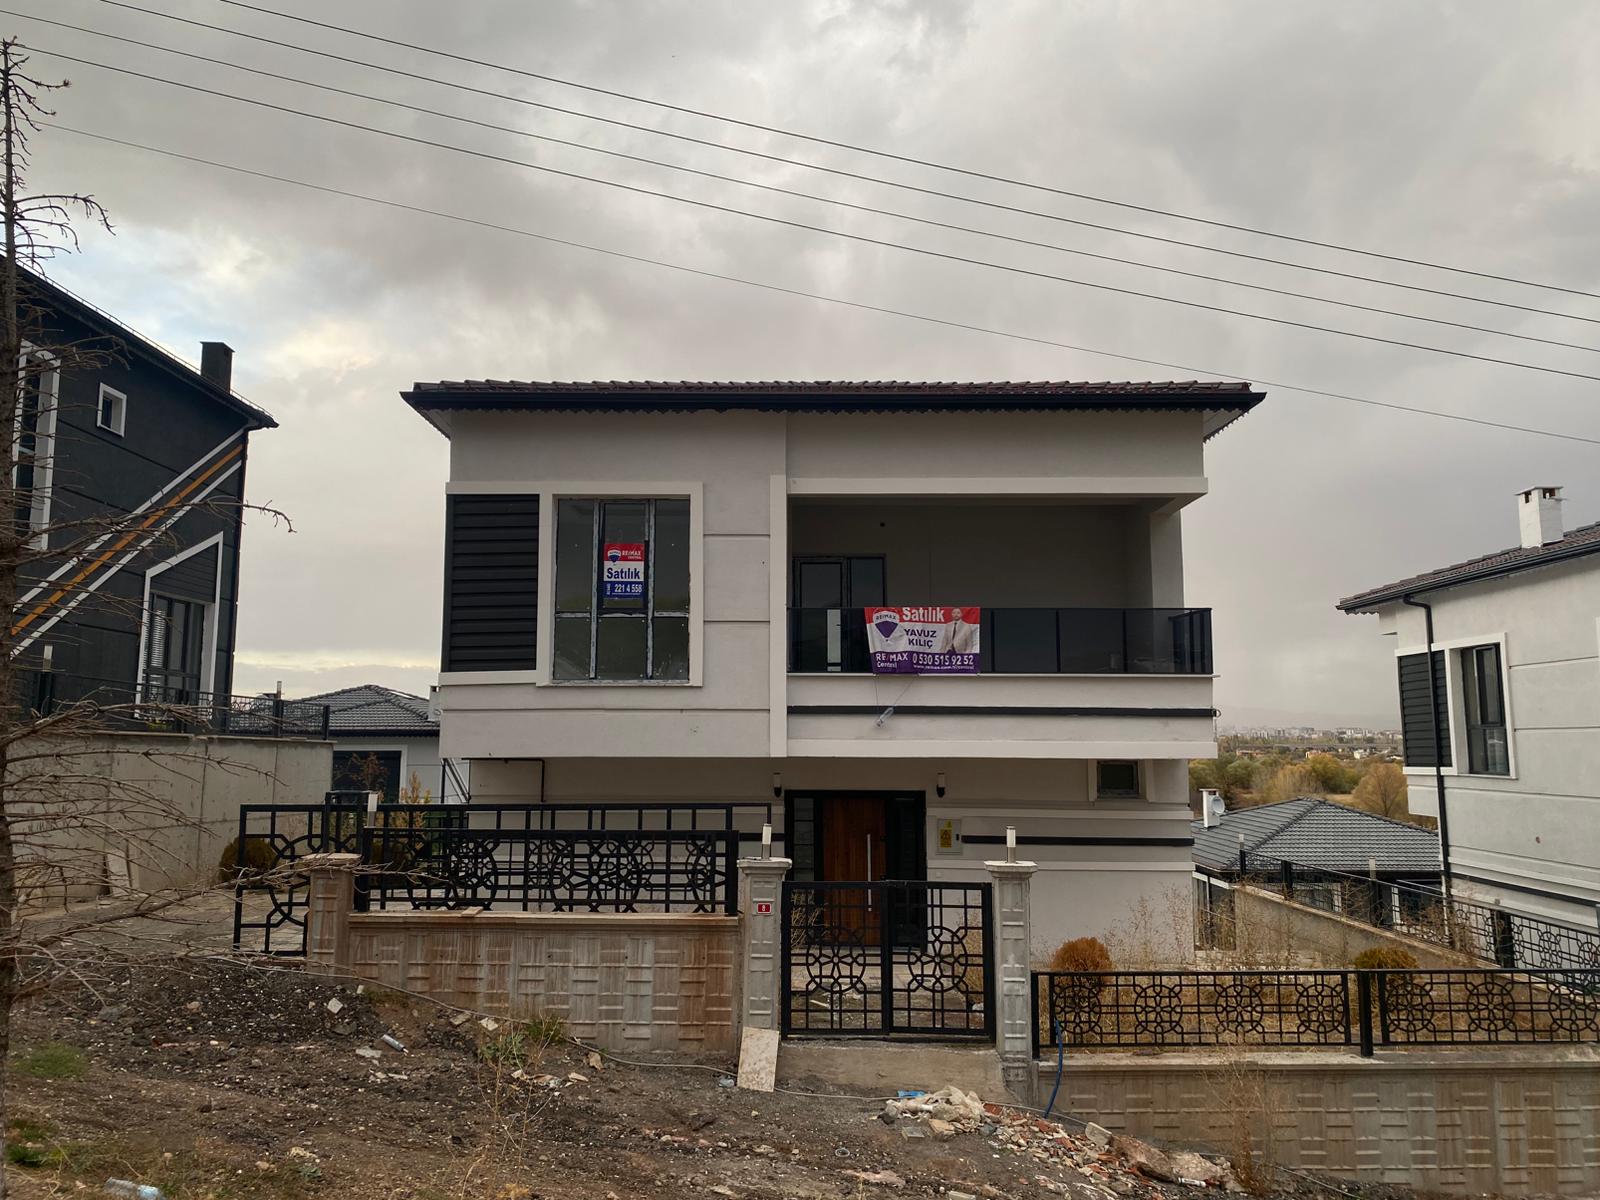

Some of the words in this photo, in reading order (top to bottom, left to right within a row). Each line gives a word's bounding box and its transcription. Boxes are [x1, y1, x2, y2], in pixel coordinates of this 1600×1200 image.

[606, 567, 641, 580] Satılık
[902, 606, 945, 622] Satılık
[904, 628, 937, 638] YAVUZ
[908, 638, 933, 649] KILIÇ
[875, 652, 909, 662] RE/MAX
[912, 653, 918, 664] 0
[919, 654, 933, 665] 530
[934, 654, 950, 666] 515
[951, 655, 961, 666] 92
[963, 654, 974, 666] 52
